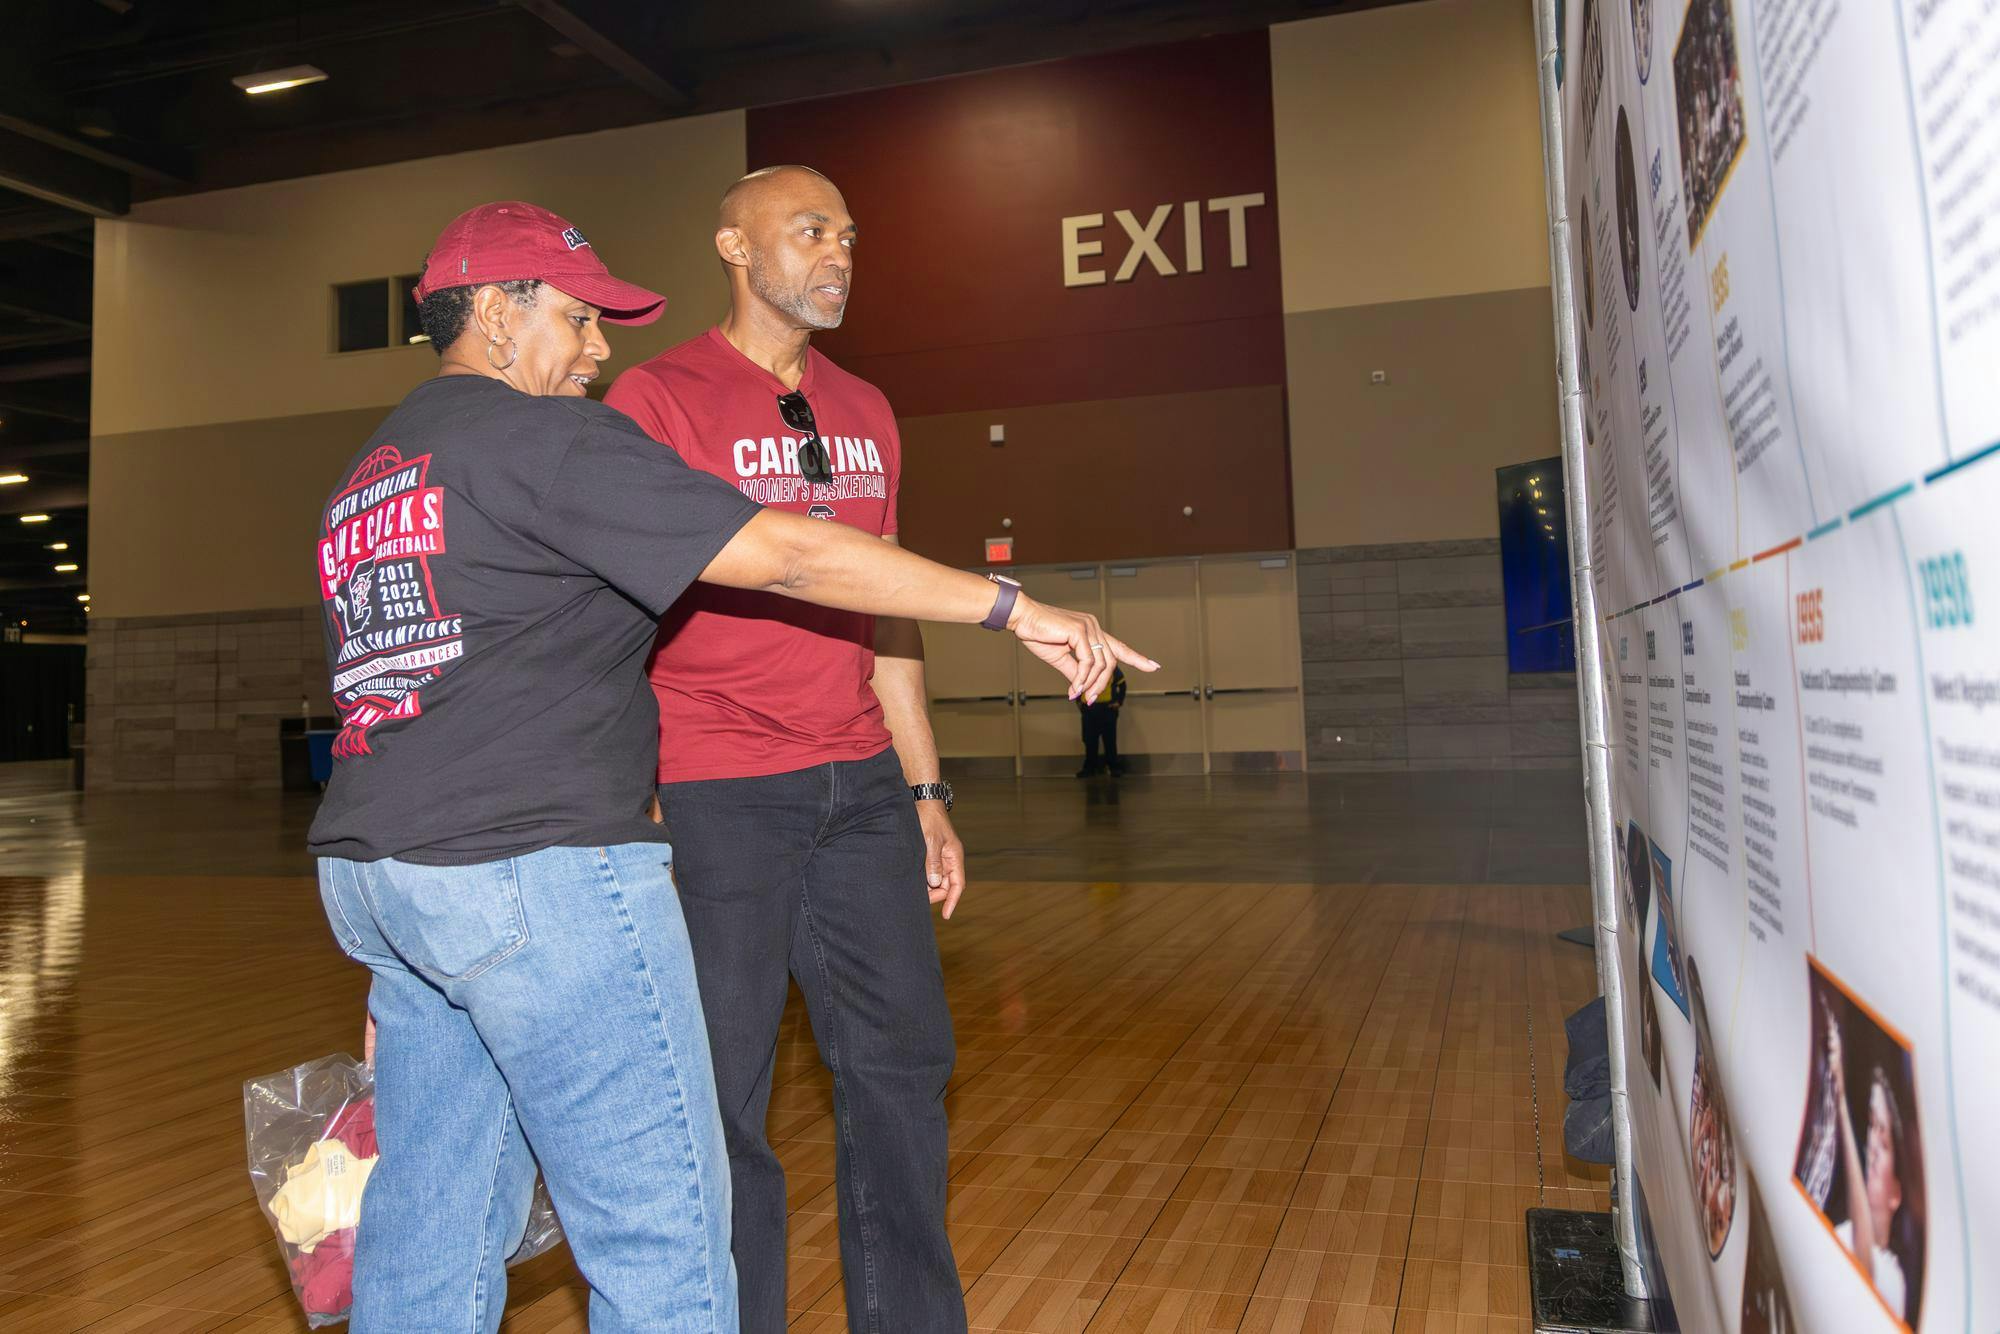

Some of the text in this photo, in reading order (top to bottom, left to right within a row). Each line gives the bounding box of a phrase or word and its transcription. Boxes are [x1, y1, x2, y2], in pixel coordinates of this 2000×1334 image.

[1062, 192, 1265, 287] EXIT
[331, 467, 417, 528] SOUTH CAROLINA
[739, 477, 810, 503] WOMEN'S
[378, 562, 413, 583] 2017
[380, 581, 421, 602] 2022
[383, 599, 426, 620] 2024
[1796, 588, 1824, 645] 1995
[366, 619, 462, 650] CHAMPIONS
